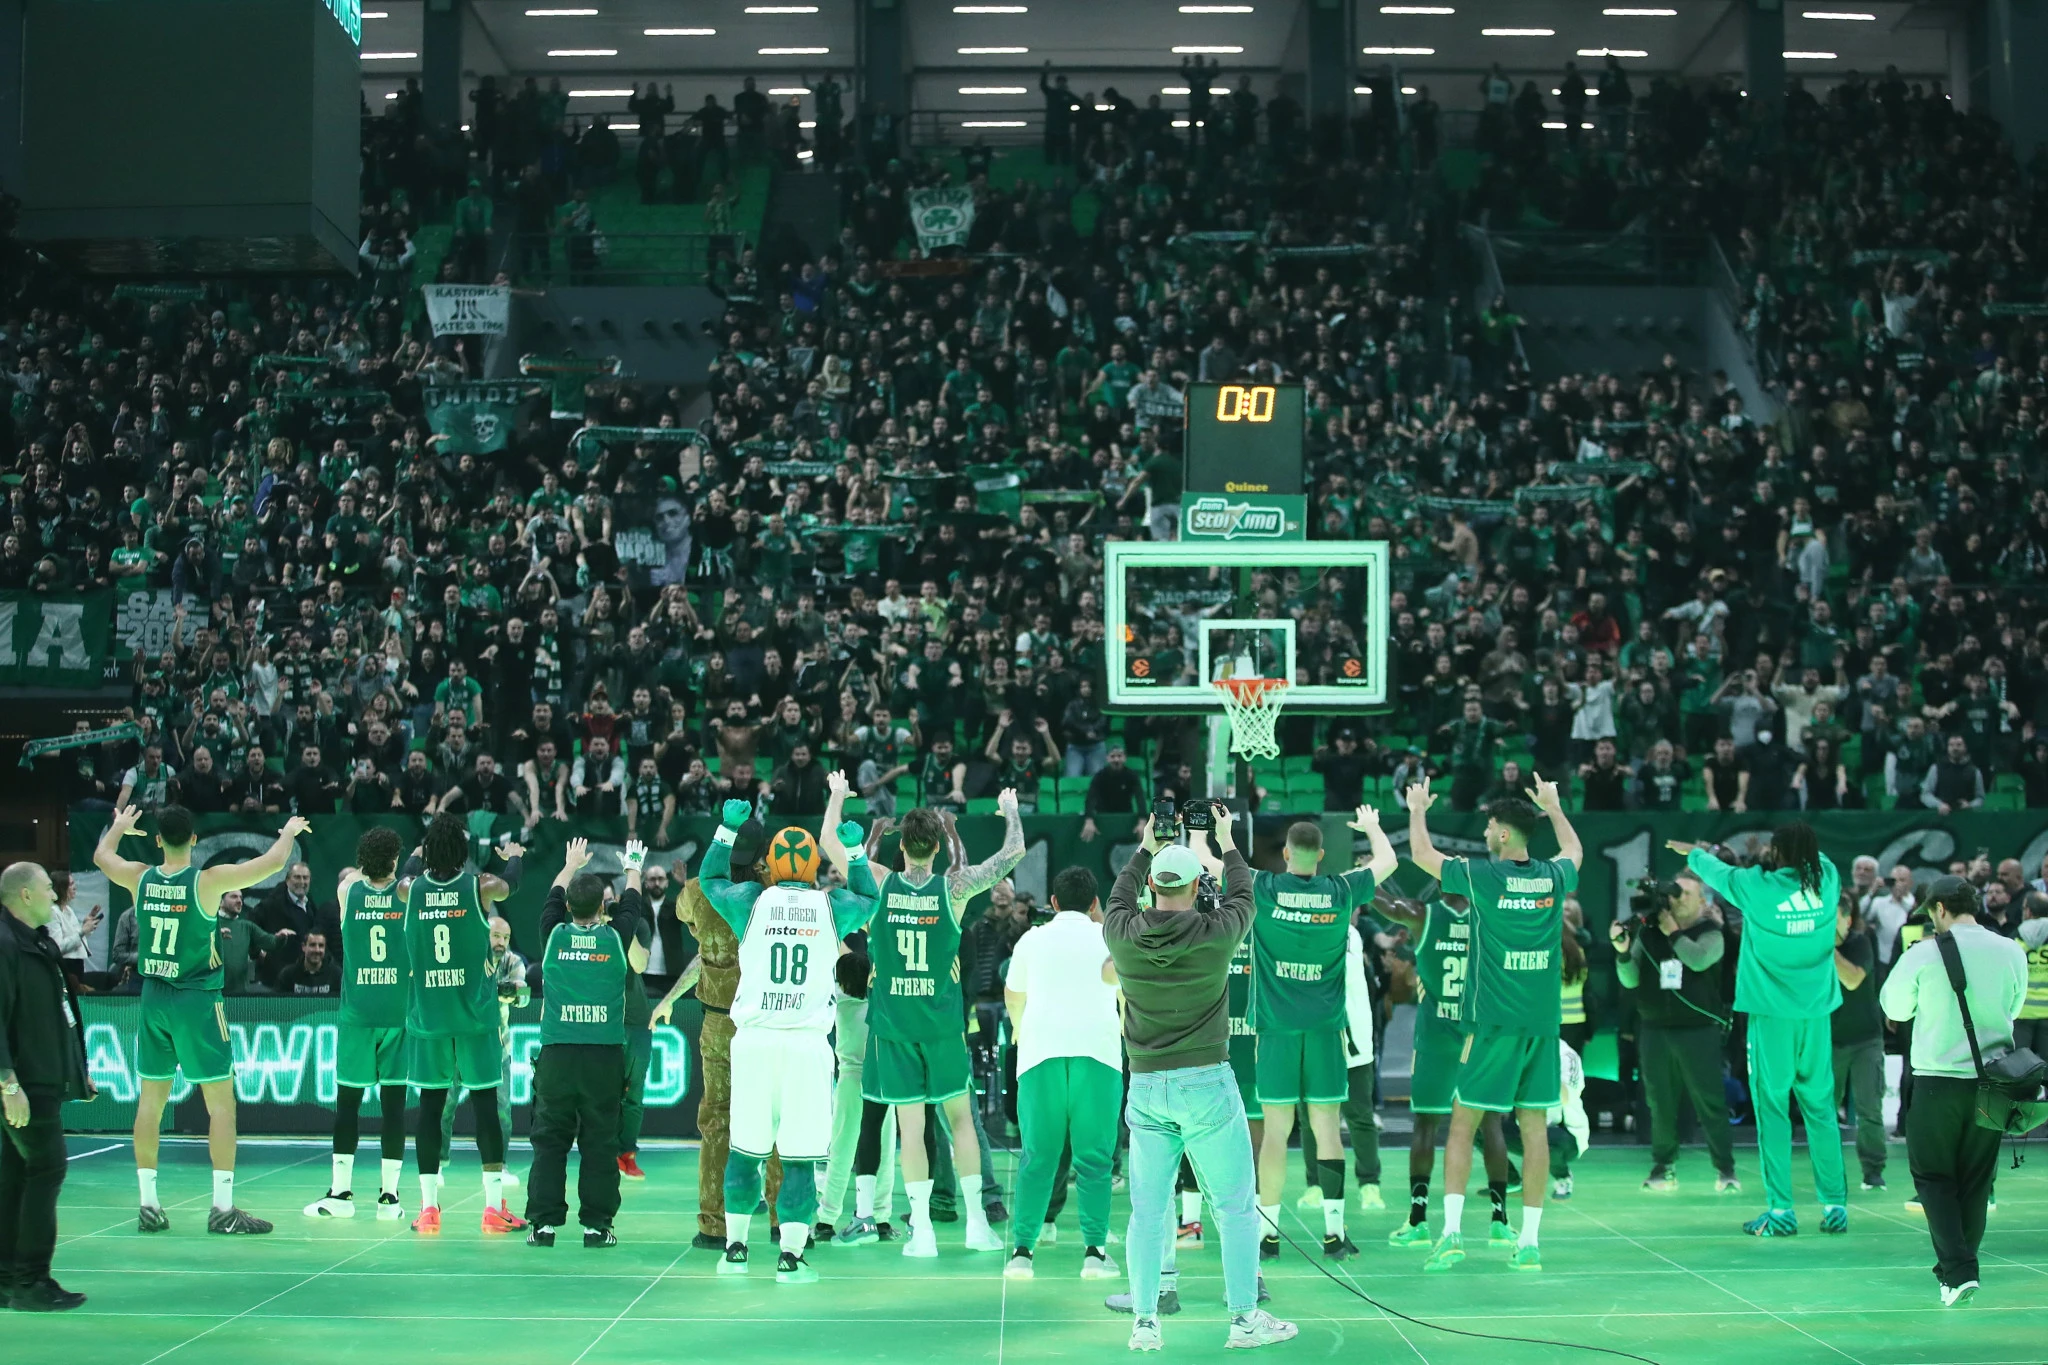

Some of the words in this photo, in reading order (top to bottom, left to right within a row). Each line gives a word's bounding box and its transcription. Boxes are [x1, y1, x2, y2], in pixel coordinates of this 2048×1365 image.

[1225, 481, 1269, 492] Quince
[103, 667, 120, 678] XIT
[143, 900, 187, 913] instacar
[364, 895, 392, 908] OSMAN
[425, 891, 459, 907] HOLMES
[1497, 895, 1554, 910] instaca
[355, 910, 403, 921] instacar
[418, 908, 467, 920] instacar
[770, 906, 786, 921] MR.
[788, 907, 817, 923] GREEN
[887, 912, 939, 925] instacar
[1271, 906, 1337, 924] instacar
[150, 916, 179, 956] 77
[764, 925, 820, 937] instacar
[370, 924, 387, 962] 6
[433, 924, 451, 963] 8
[571, 934, 596, 949] EDDIE
[558, 949, 610, 962] instacar
[896, 929, 929, 972] 41
[144, 958, 179, 978] ATHENS
[770, 942, 809, 985] 08
[1503, 950, 1550, 970] ATHENS
[357, 968, 397, 985] ATHENS
[425, 968, 465, 988] ATHENS
[1275, 960, 1322, 981] ATHENS
[890, 977, 935, 996] ATHENS
[560, 1004, 608, 1023] ATHENS
[1437, 1001, 1462, 1021] ATH
